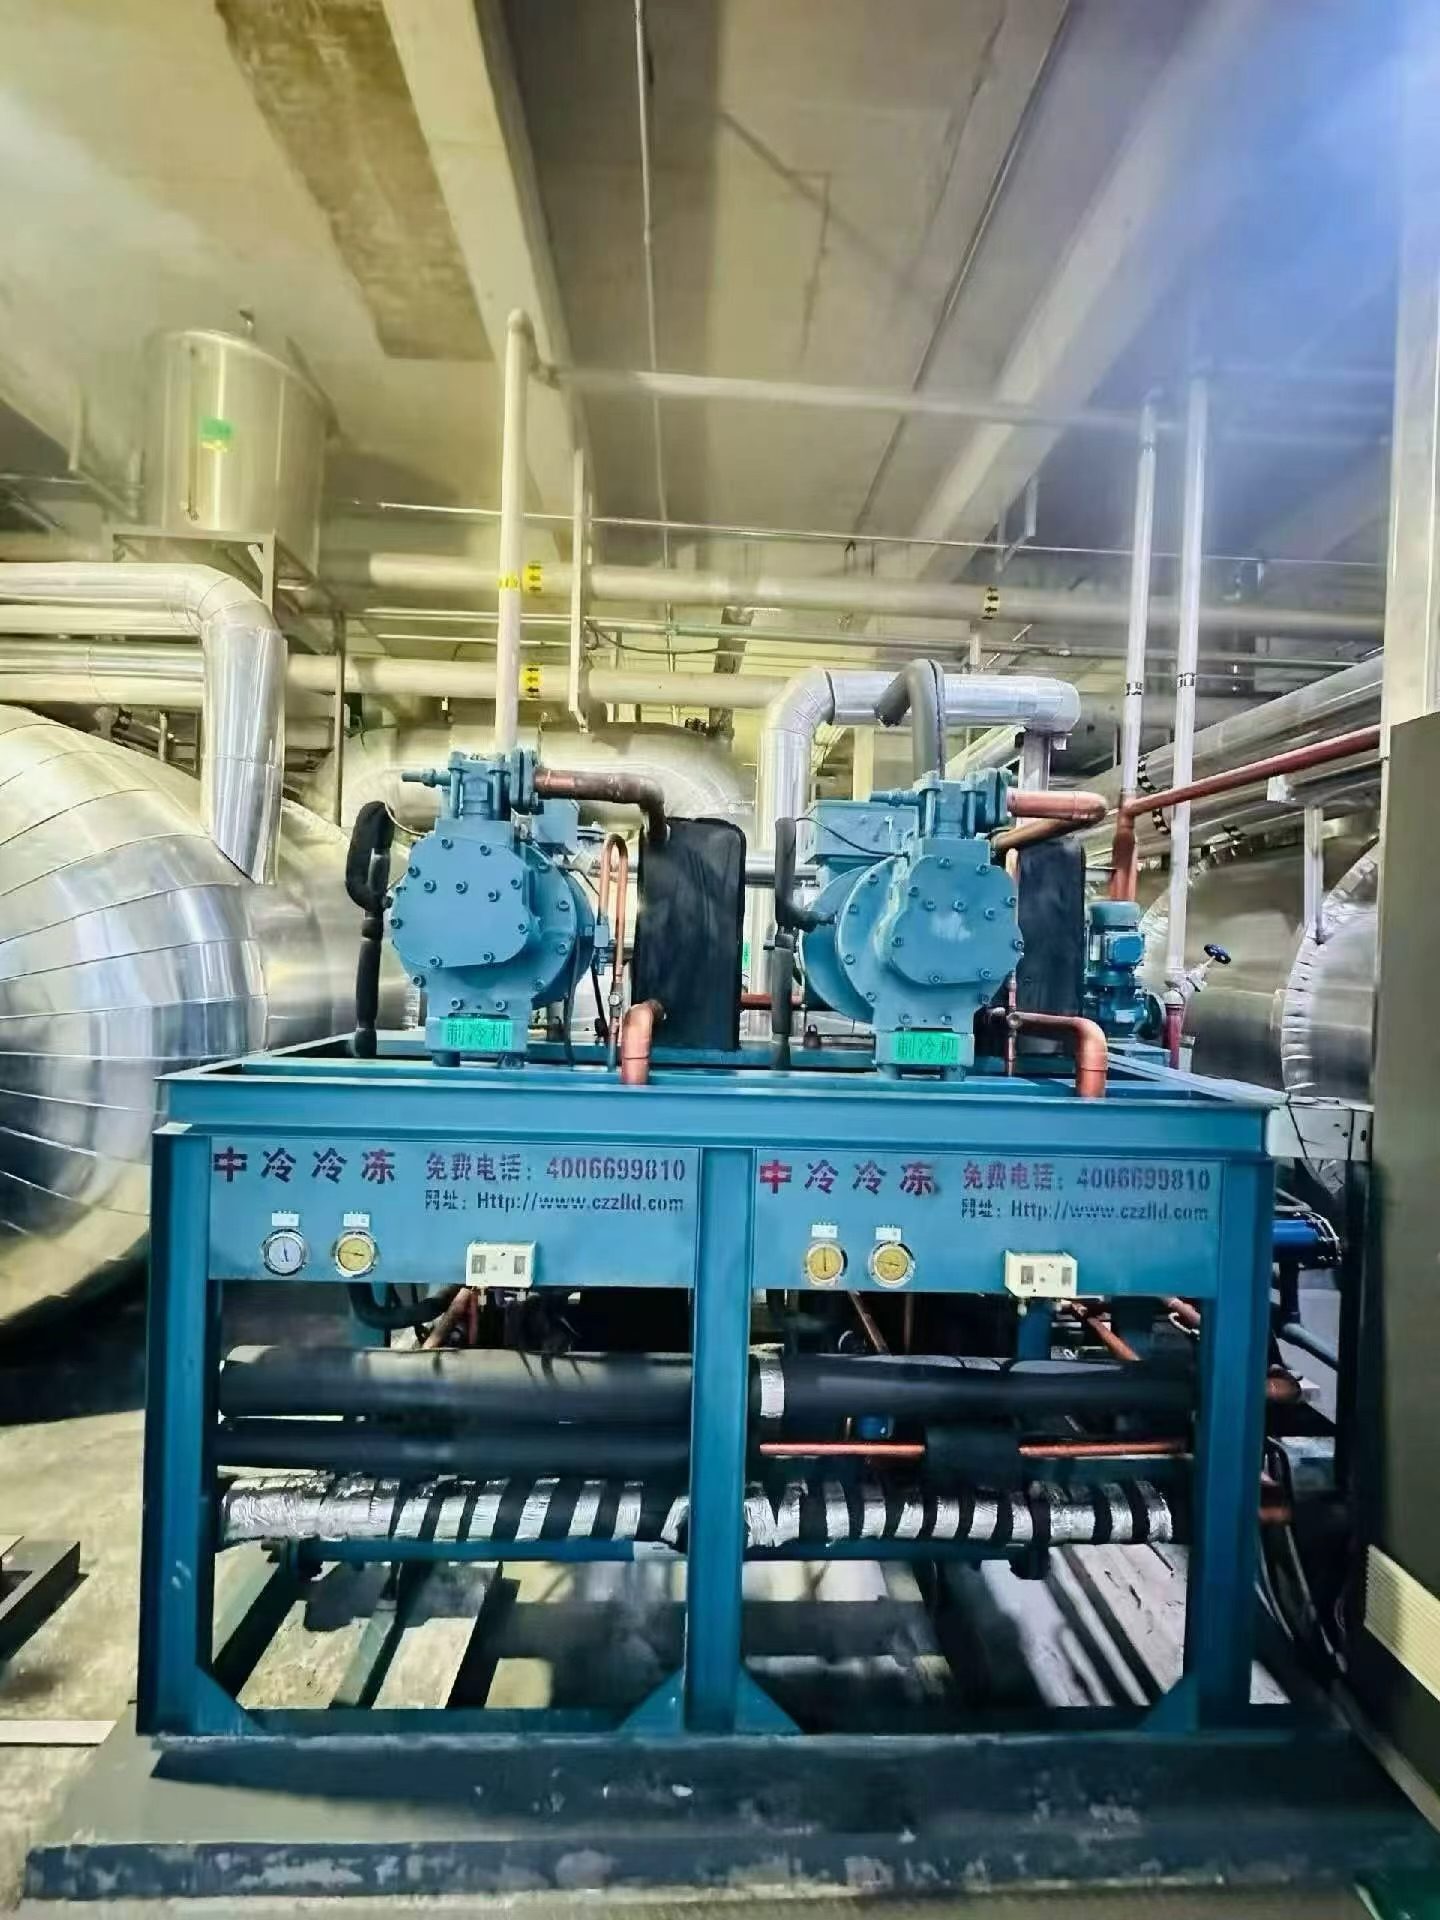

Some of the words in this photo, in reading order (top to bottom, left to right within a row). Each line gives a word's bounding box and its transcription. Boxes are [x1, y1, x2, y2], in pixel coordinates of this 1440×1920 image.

[213, 1146, 396, 1184] 中冷冷冻
[546, 1156, 686, 1182] 4006699810
[760, 1159, 935, 1195] 中冷冷冻
[1077, 1167, 1211, 1192] 4006699810
